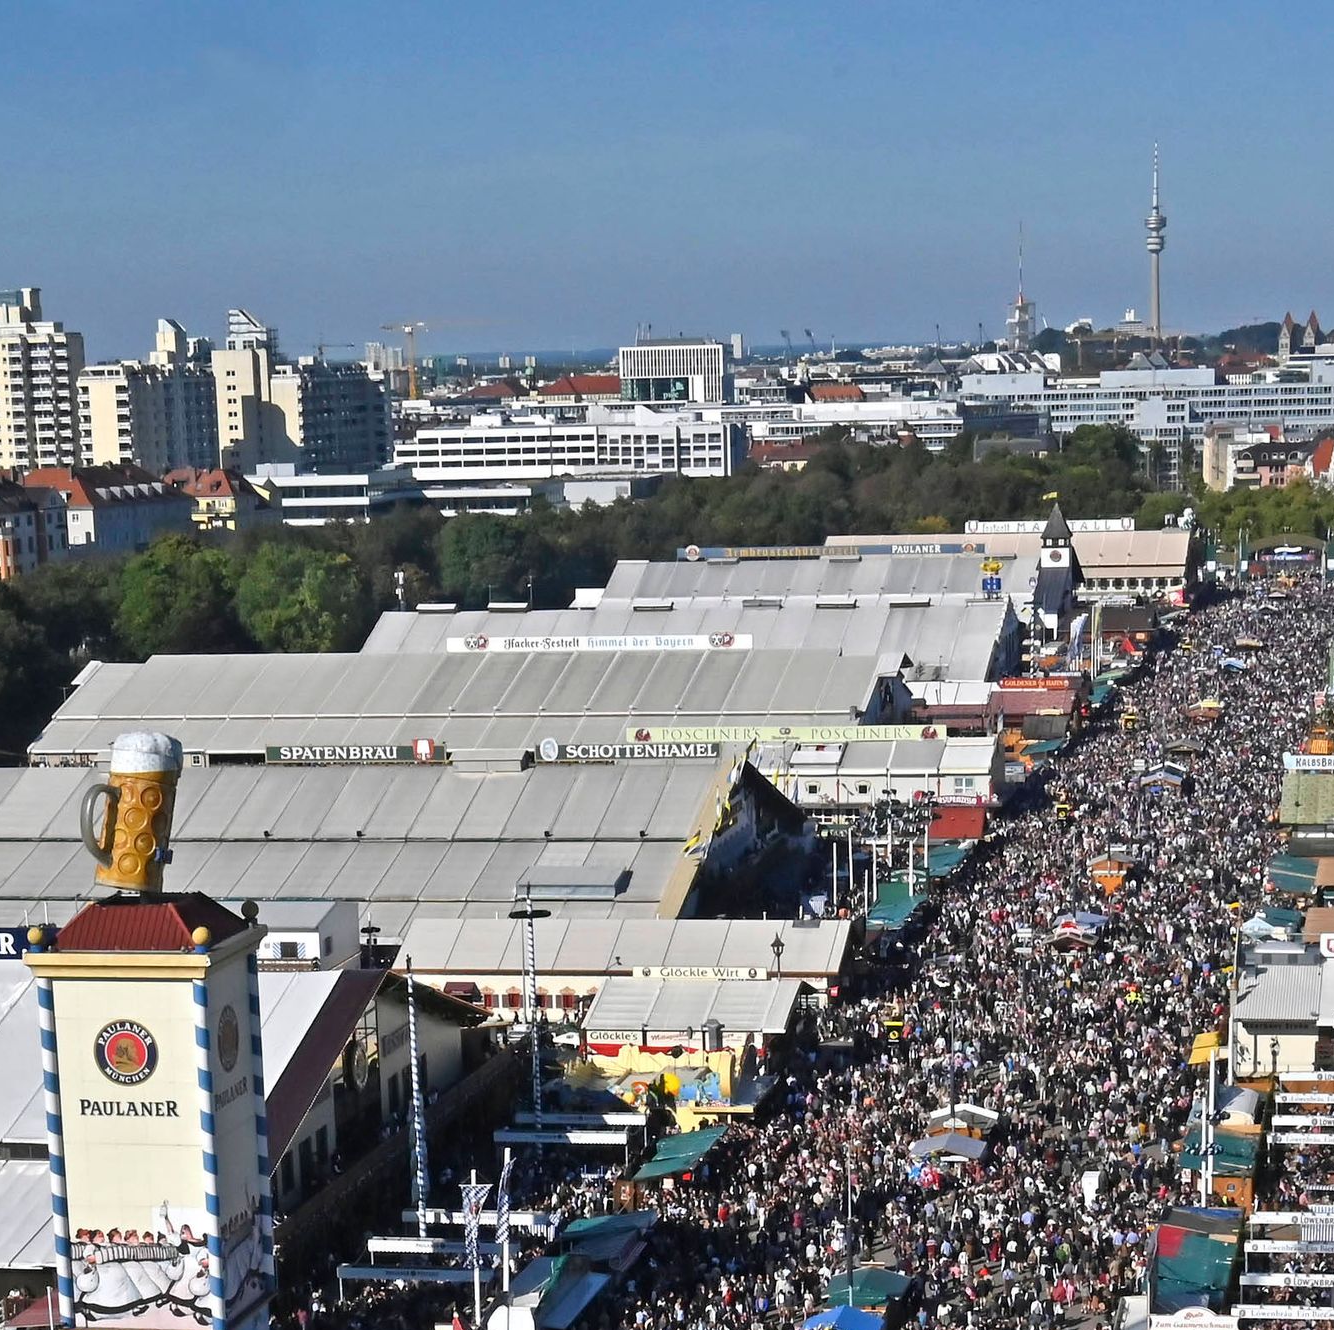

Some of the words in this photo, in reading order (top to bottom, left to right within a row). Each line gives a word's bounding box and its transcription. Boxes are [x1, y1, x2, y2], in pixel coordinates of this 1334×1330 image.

[891, 544, 942, 555] PAULANER
[587, 636, 627, 649] Himmel
[632, 636, 650, 648] der
[655, 636, 695, 650] Bayern
[661, 726, 761, 740] POSCHNER'S
[811, 725, 912, 740] POSCHNER'S
[280, 745, 398, 760] SPATENBRÄU
[566, 743, 717, 759] SCHOTTENHAMEL
[660, 967, 708, 978] Glöckle
[712, 967, 739, 978] Wirt
[98, 1022, 153, 1047] PAULANER
[589, 1031, 638, 1041] Glöckle's
[104, 1067, 151, 1084] MÜNCHEN
[79, 1098, 180, 1118] PAULANER
